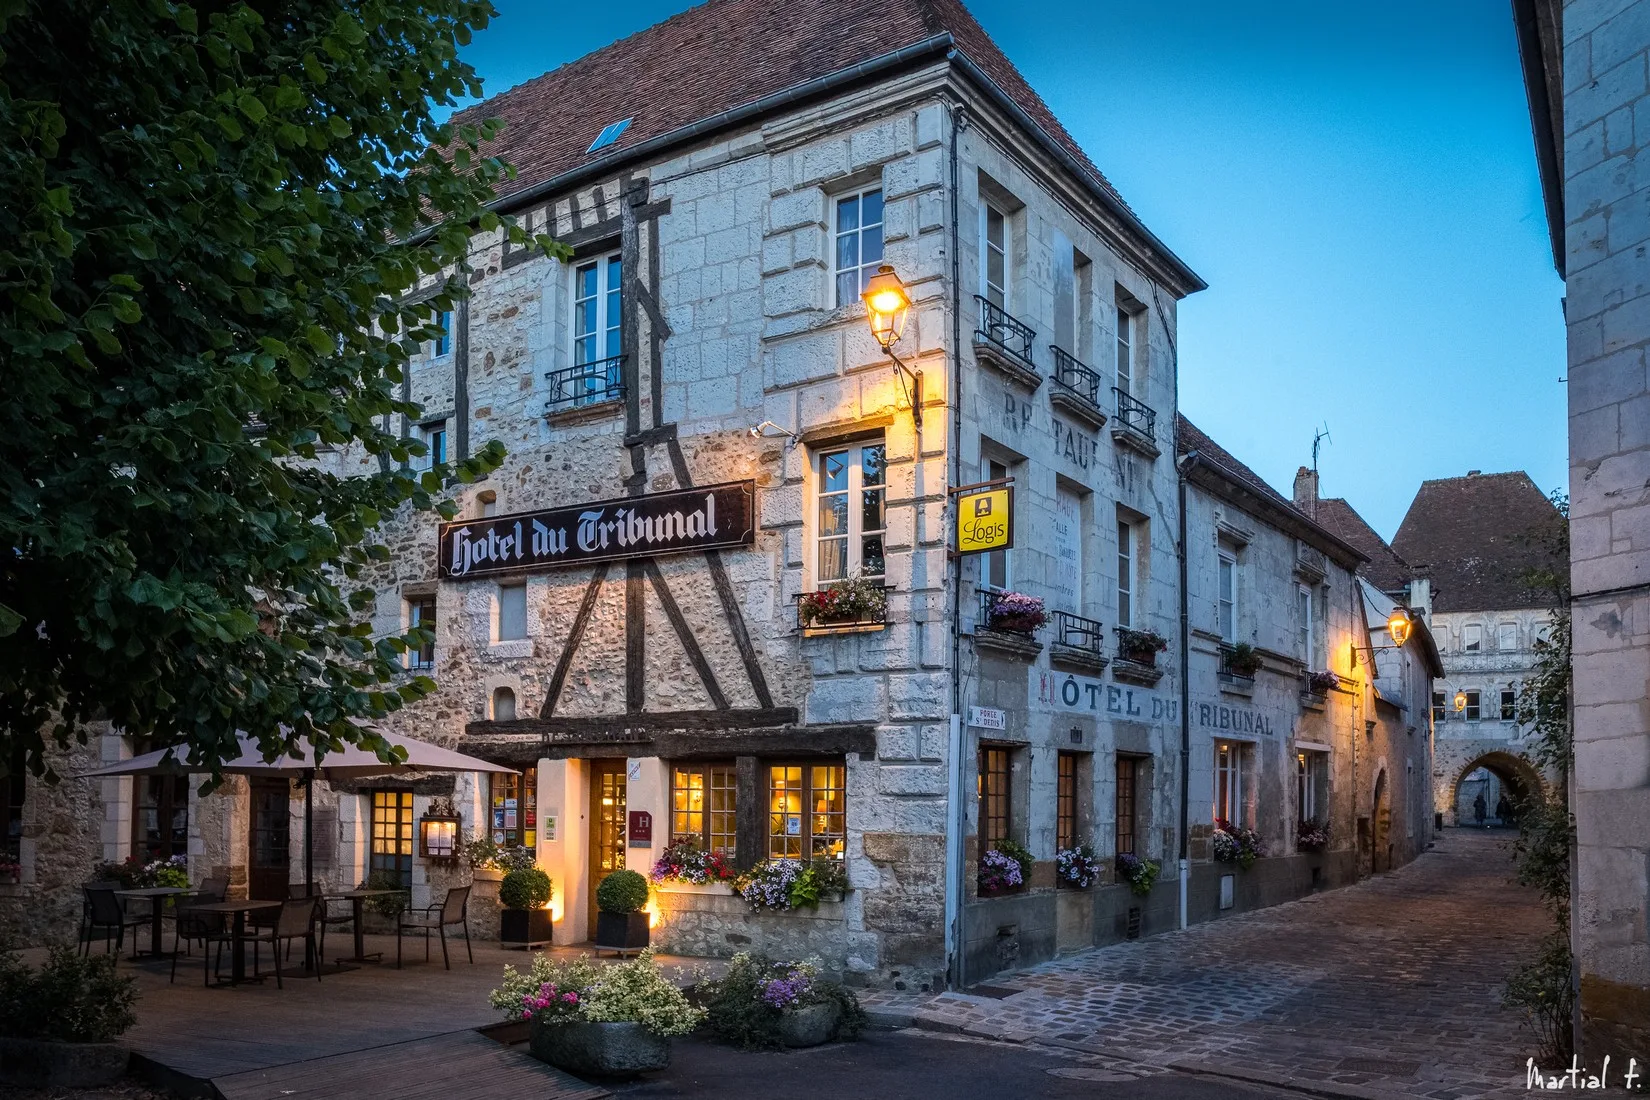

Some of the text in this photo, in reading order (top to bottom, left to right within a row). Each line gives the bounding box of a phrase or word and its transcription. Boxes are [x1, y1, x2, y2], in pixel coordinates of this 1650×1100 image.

[450, 492, 719, 577] Hotel du Tribunal
[962, 518, 1005, 545] Logis
[1151, 698, 1178, 722] DU
[639, 816, 649, 827] H
